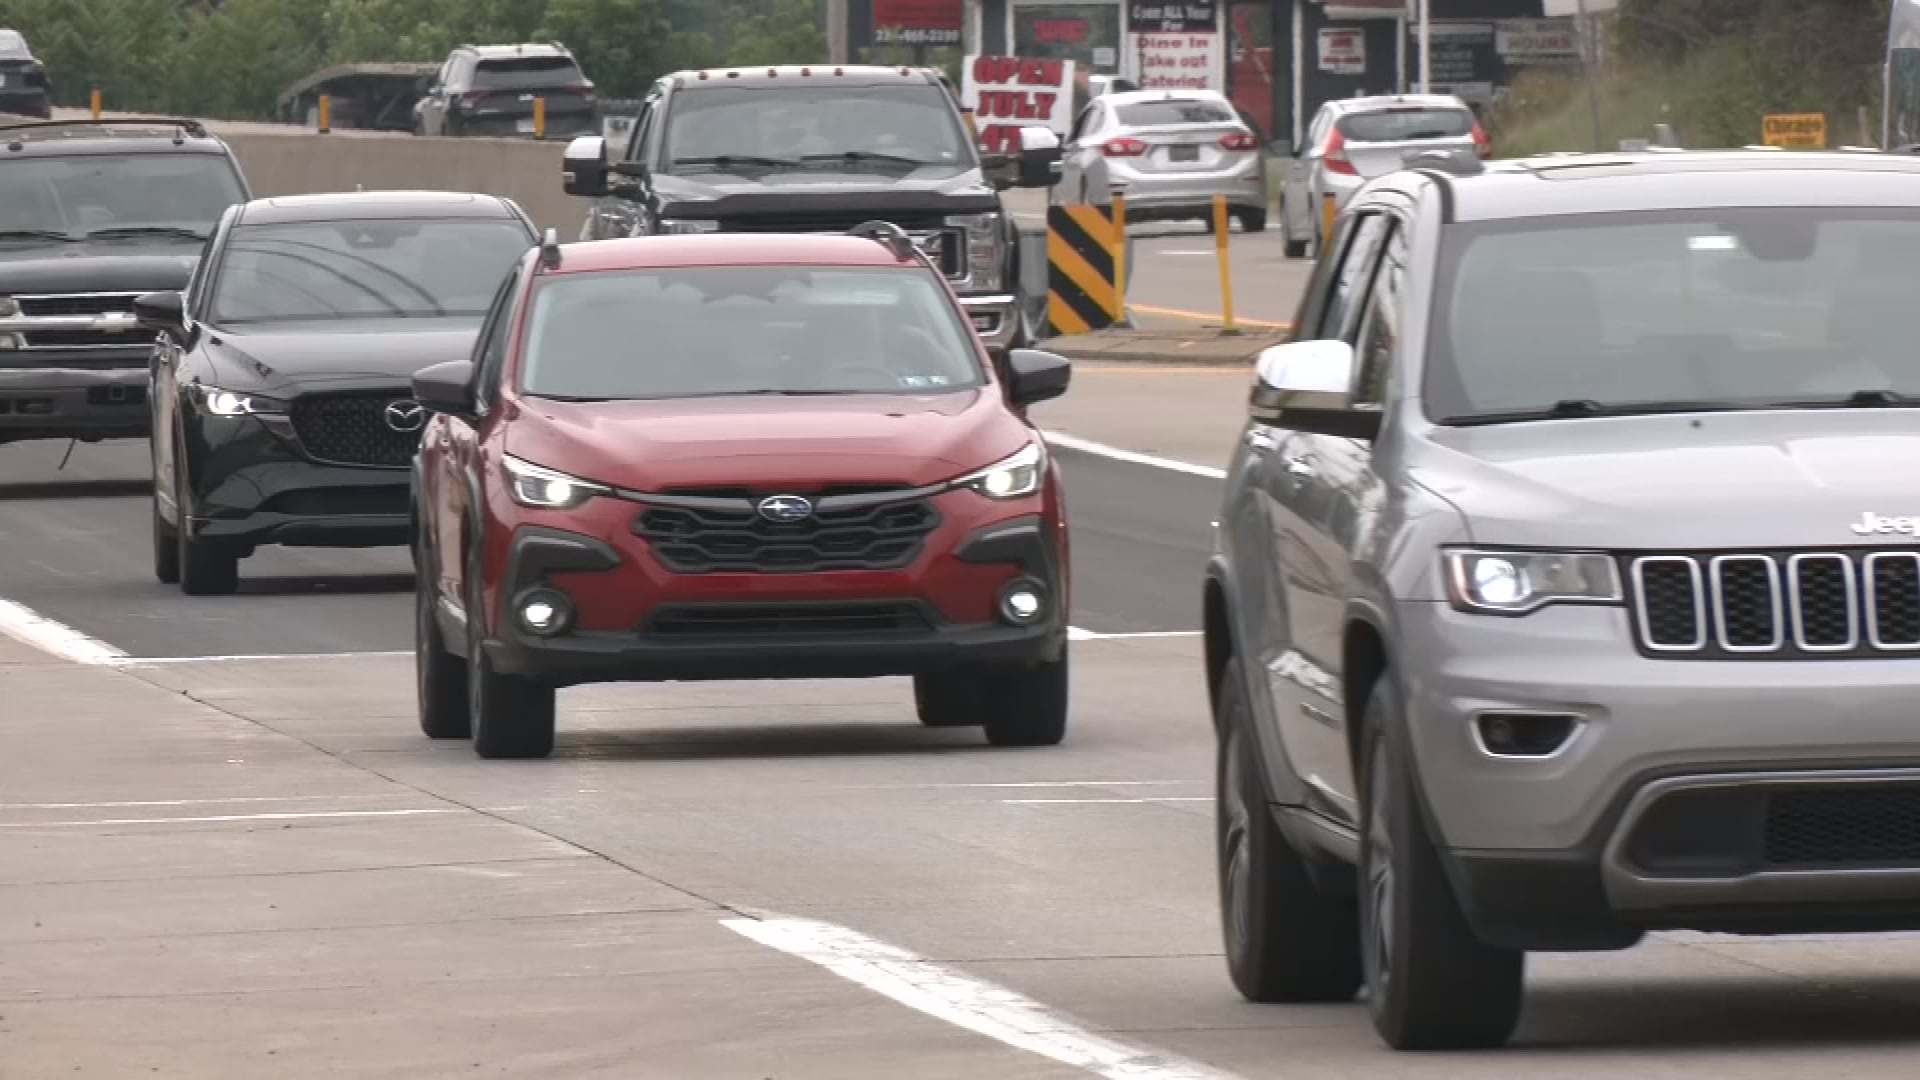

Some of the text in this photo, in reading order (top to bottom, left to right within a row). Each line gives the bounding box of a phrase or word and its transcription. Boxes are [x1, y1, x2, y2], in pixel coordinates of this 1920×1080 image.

[974, 57, 1063, 87] OPEN
[1181, 54, 1208, 68] out
[976, 91, 1057, 120] JULY
[981, 124, 1024, 154] 4T
